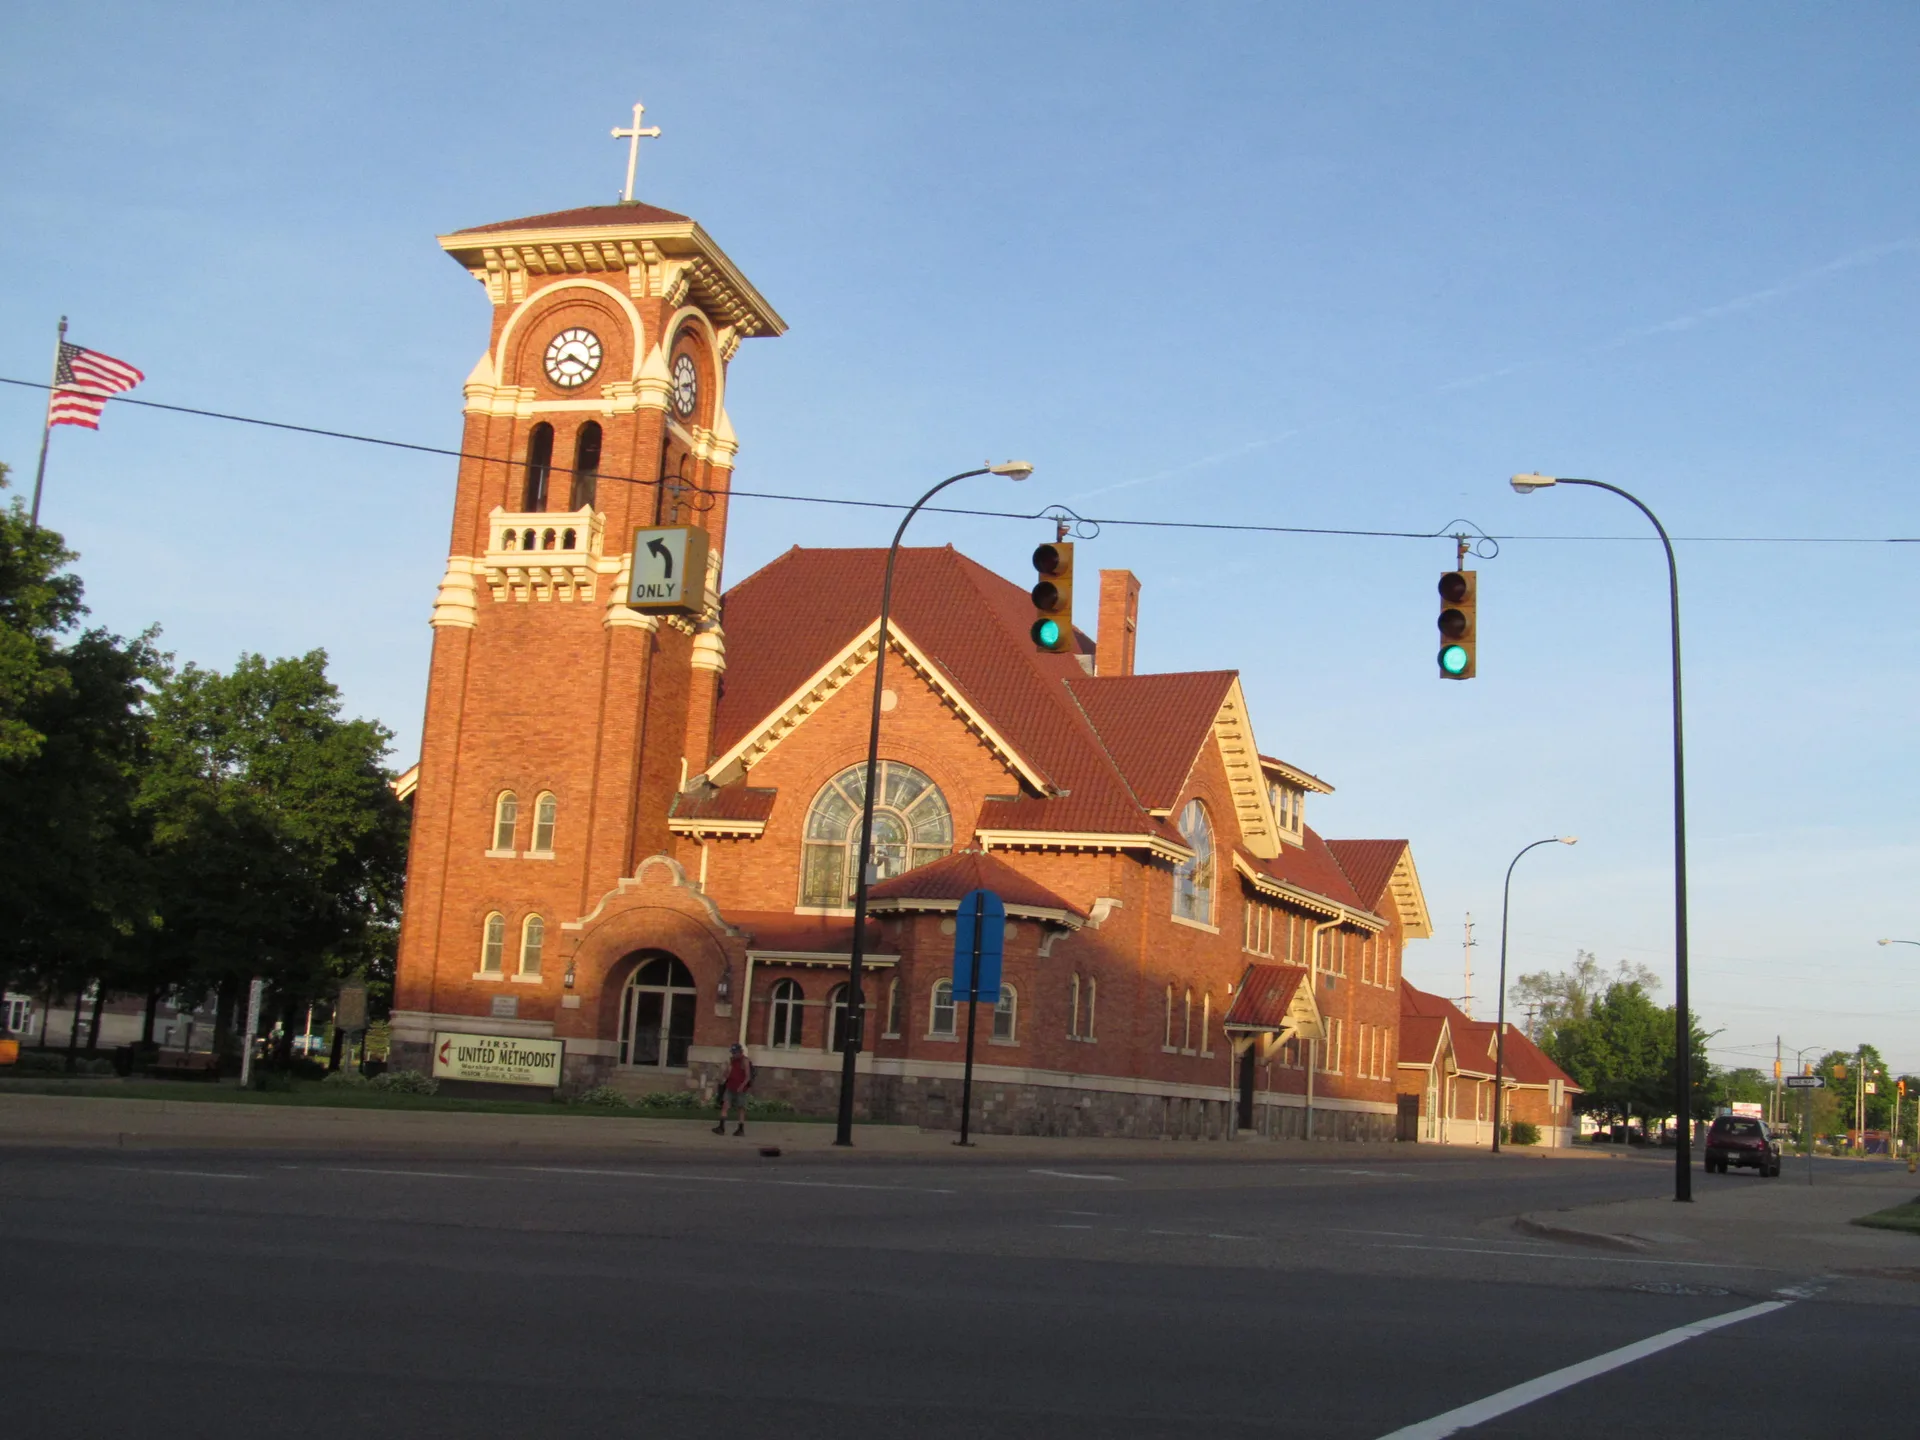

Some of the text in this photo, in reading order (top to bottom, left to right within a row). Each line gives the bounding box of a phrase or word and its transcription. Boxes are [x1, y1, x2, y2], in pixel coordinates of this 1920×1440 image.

[636, 583, 676, 598] ONLY
[480, 1040, 517, 1049] FIRST
[458, 1046, 556, 1068] UNITED METHODIST
